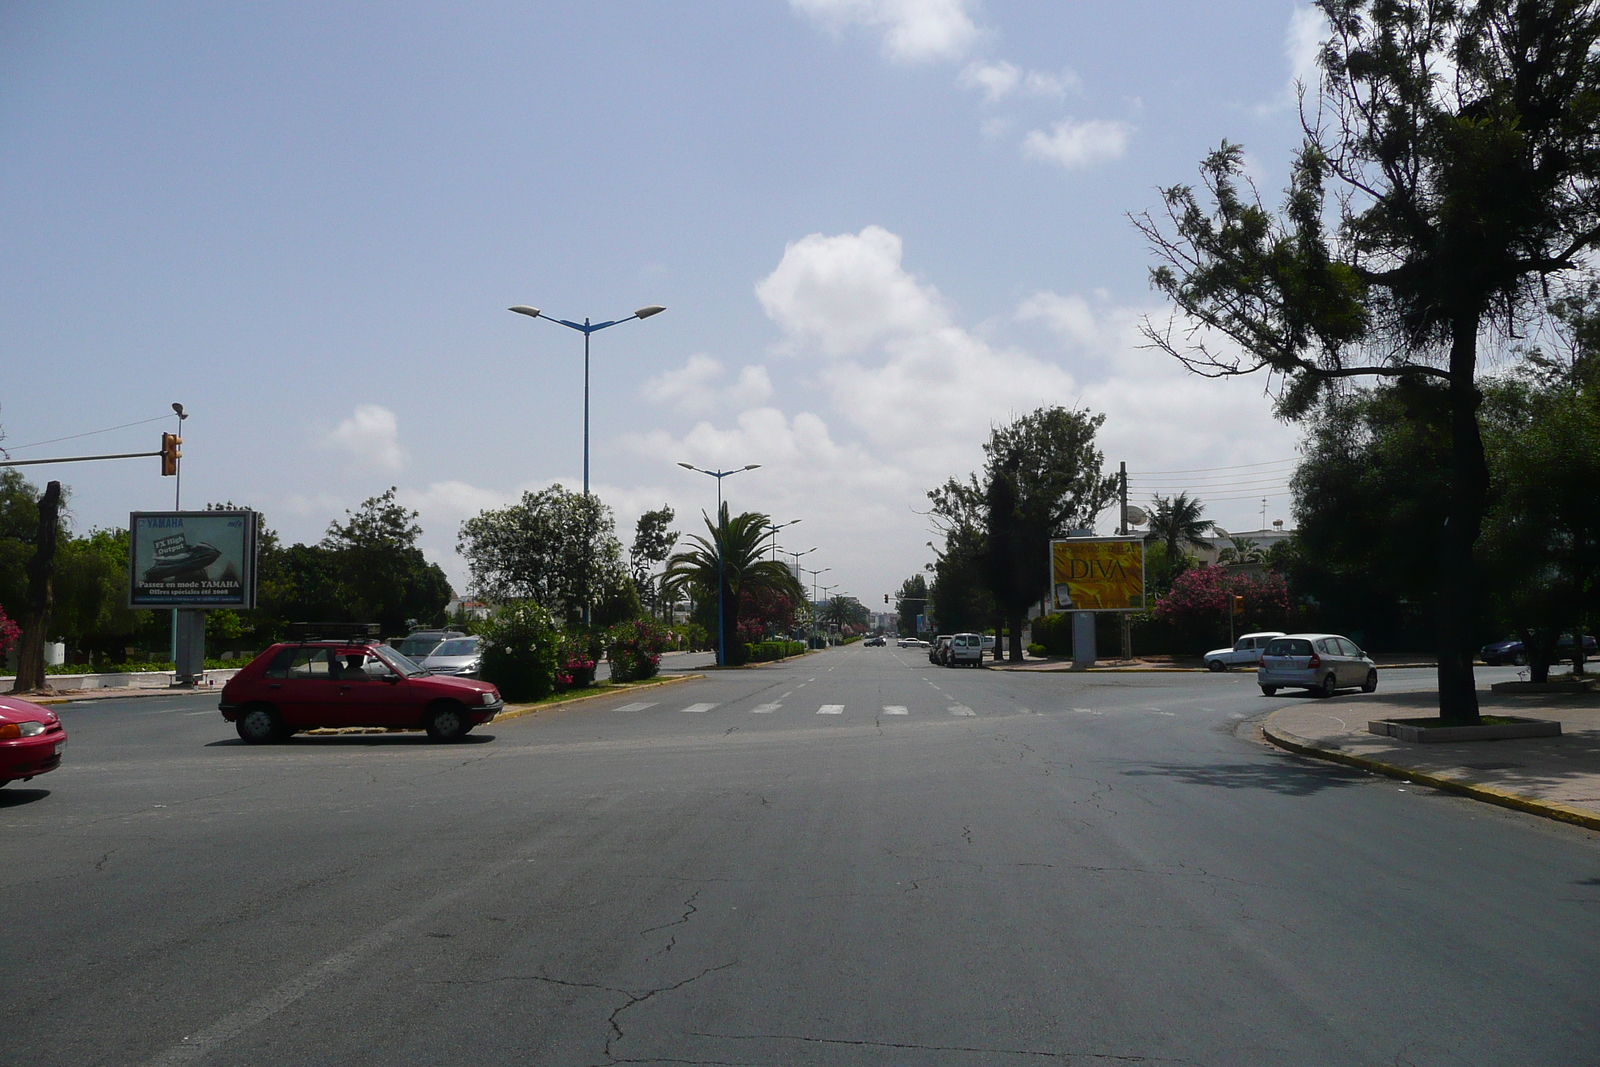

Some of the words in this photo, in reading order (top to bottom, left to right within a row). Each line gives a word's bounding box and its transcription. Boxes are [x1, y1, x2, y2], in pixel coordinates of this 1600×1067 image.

[148, 518, 184, 528] YAMAHA
[155, 540, 166, 549] FX
[158, 543, 184, 554] Output
[1070, 559, 1127, 579] DIVA
[171, 588, 200, 596] spéciales
